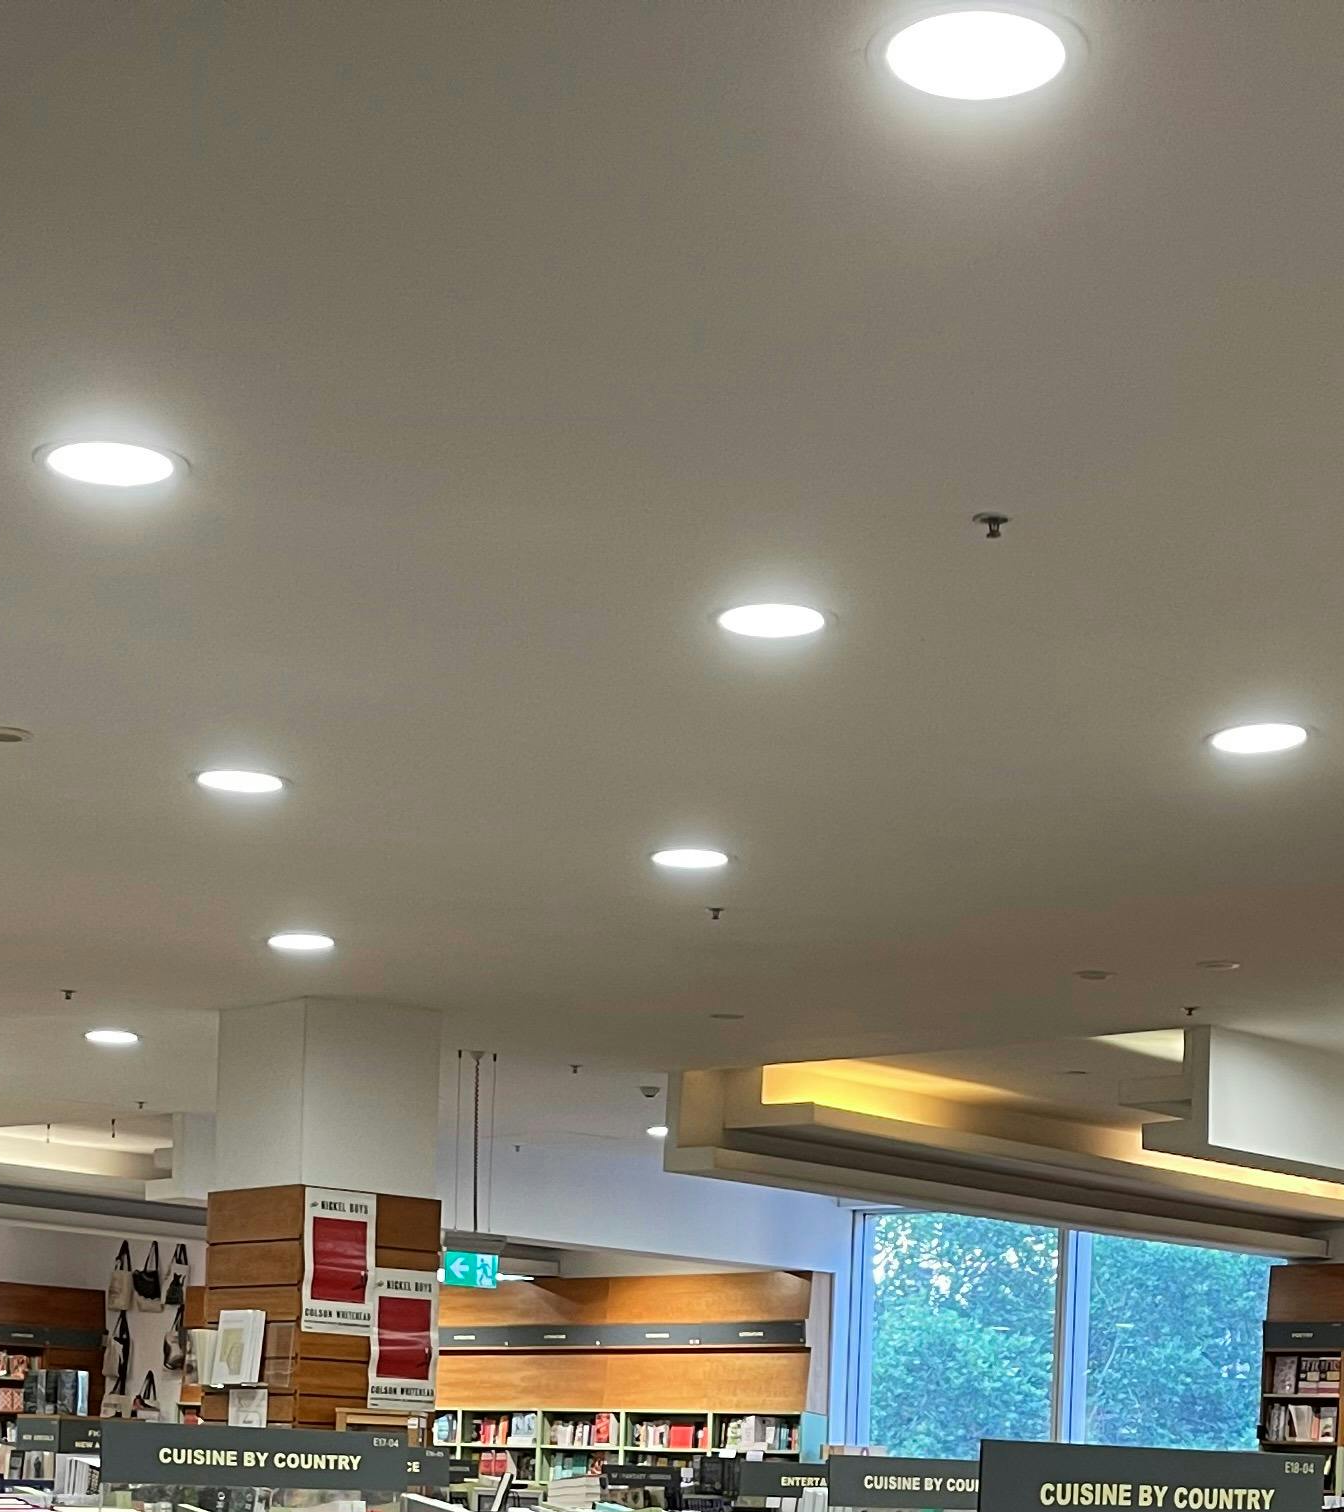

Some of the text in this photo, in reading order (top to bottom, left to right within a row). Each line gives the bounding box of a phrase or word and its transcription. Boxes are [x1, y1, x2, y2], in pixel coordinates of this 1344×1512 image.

[304, 1308, 333, 1319] COLSON
[371, 1385, 397, 1395] COLSON
[373, 1437, 399, 1448] E17-04
[158, 1447, 361, 1471] CUISINE BY COUNTRY
[1284, 1461, 1314, 1474] E18-04
[864, 1475, 920, 1491] CUISINE
[924, 1477, 943, 1491] BY
[1040, 1483, 1274, 1510] CUISINE BY COUNTRY
